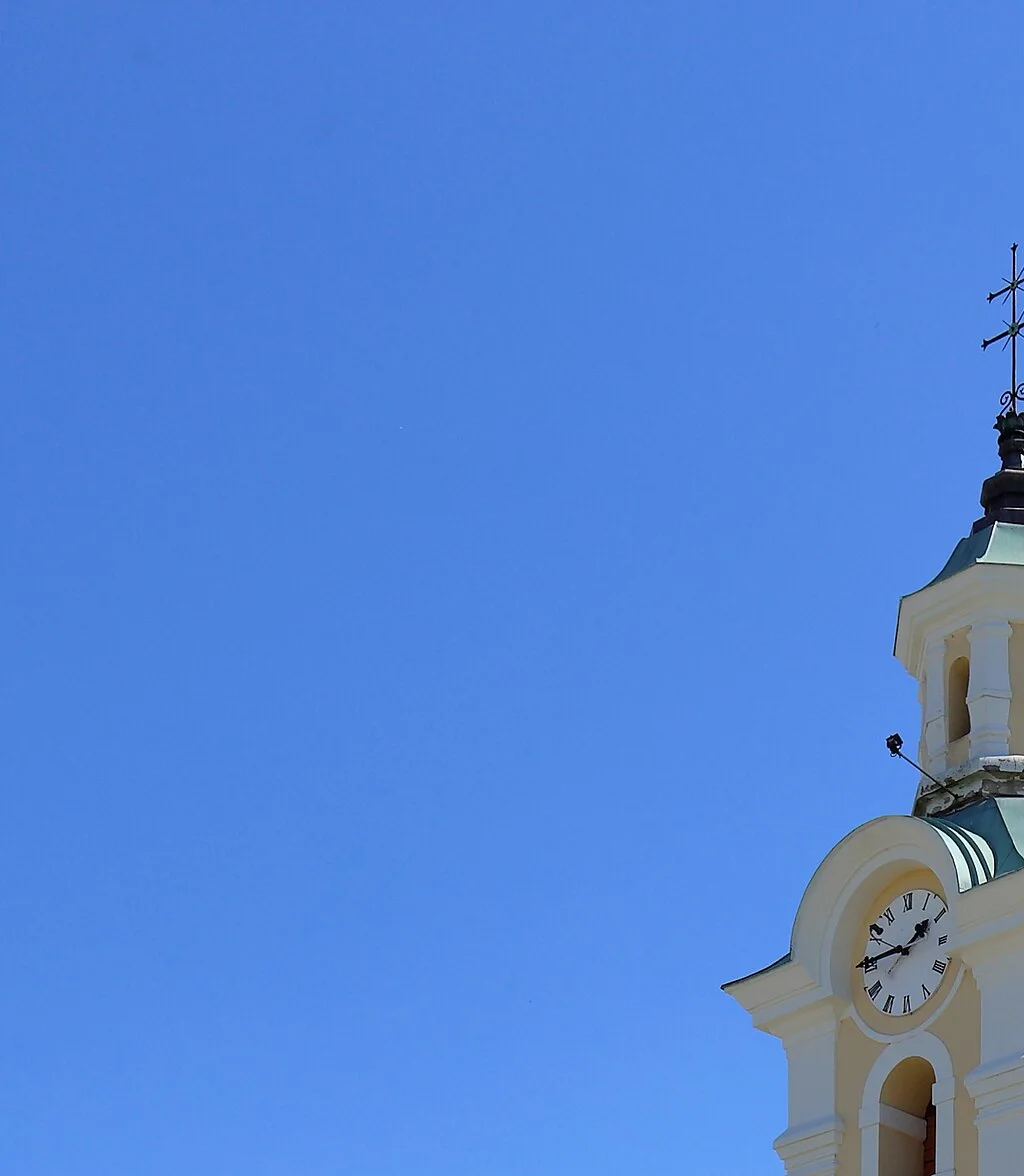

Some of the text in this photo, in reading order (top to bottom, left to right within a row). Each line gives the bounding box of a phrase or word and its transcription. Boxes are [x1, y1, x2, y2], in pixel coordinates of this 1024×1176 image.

[903, 893, 912, 912] XII
[884, 907, 895, 925] XI
[933, 907, 947, 924] II
[938, 935, 948, 946] III
